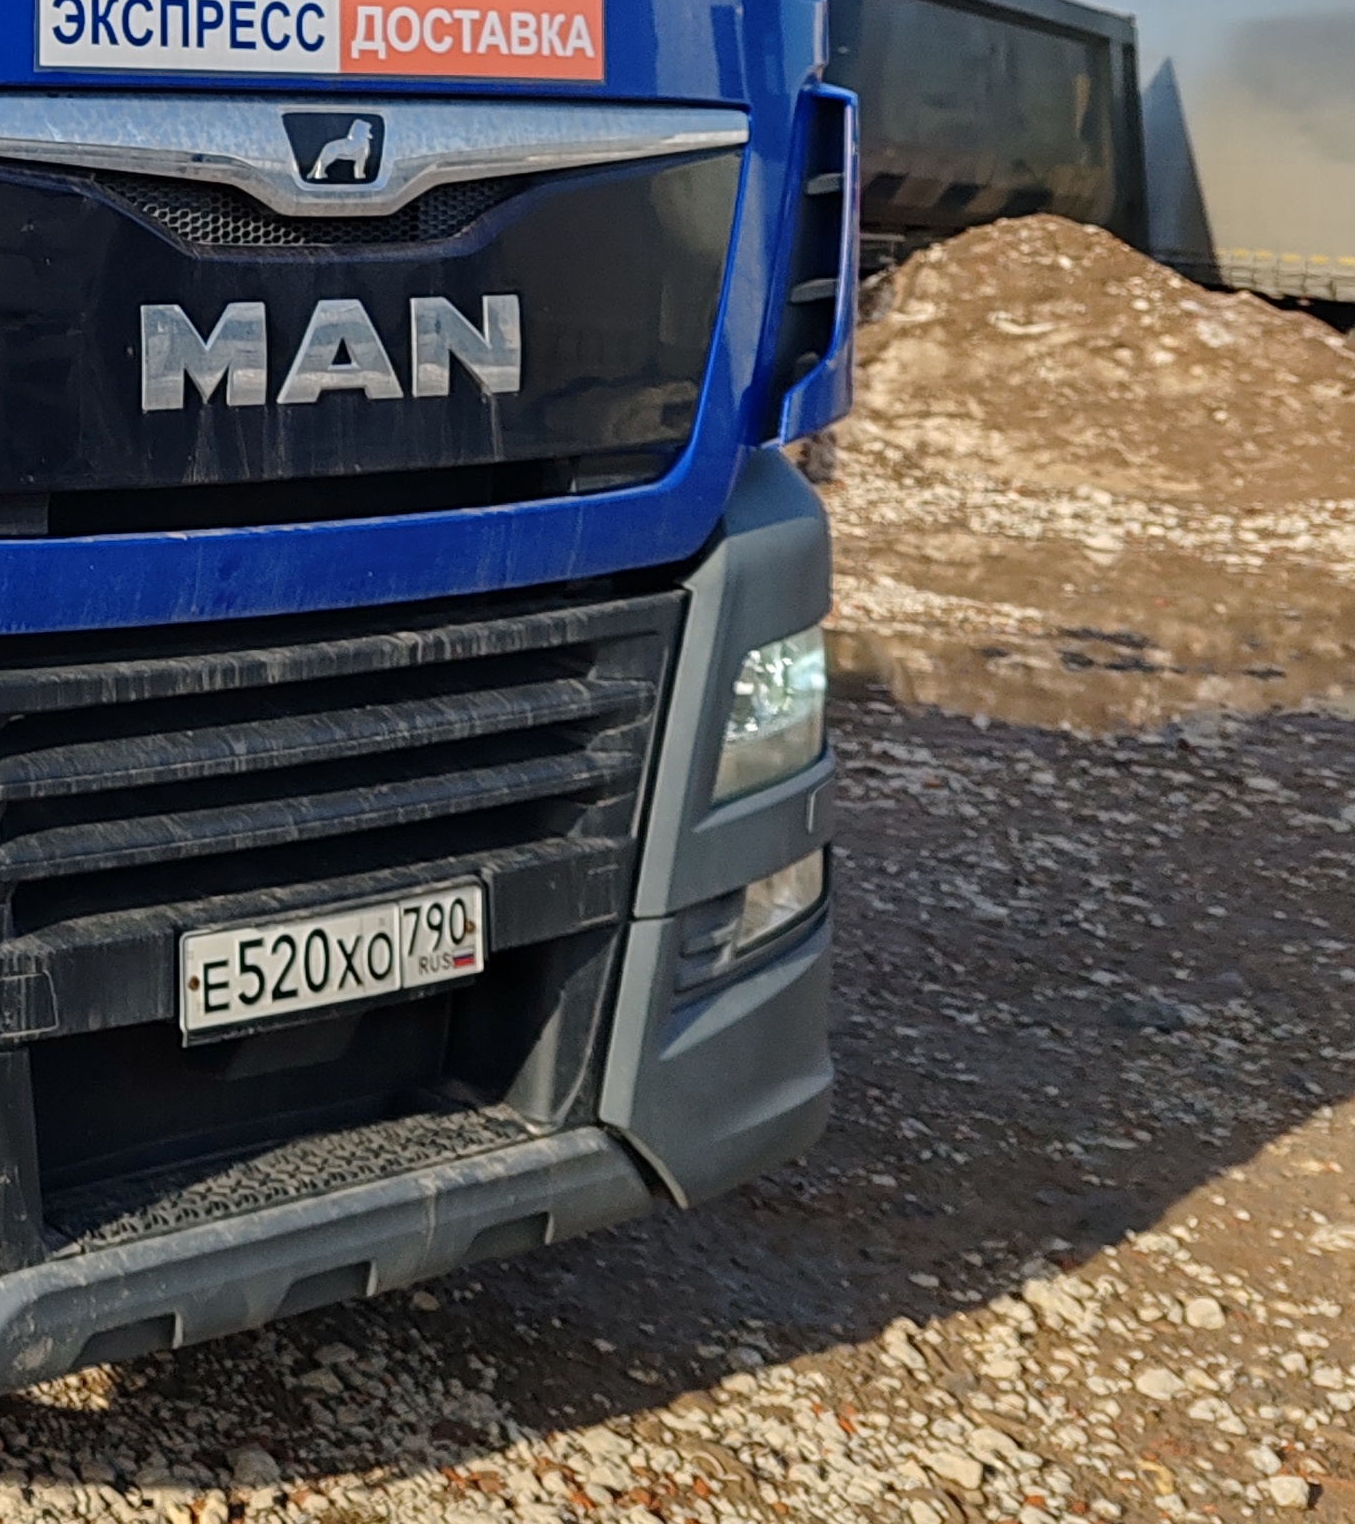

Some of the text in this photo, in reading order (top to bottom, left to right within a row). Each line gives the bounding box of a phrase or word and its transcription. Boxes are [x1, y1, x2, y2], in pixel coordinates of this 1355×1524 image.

[351, 6, 595, 59] ДОСТАВКА
[139, 294, 522, 412] MAN
[404, 897, 468, 957] 790
[419, 952, 453, 975] RUS
